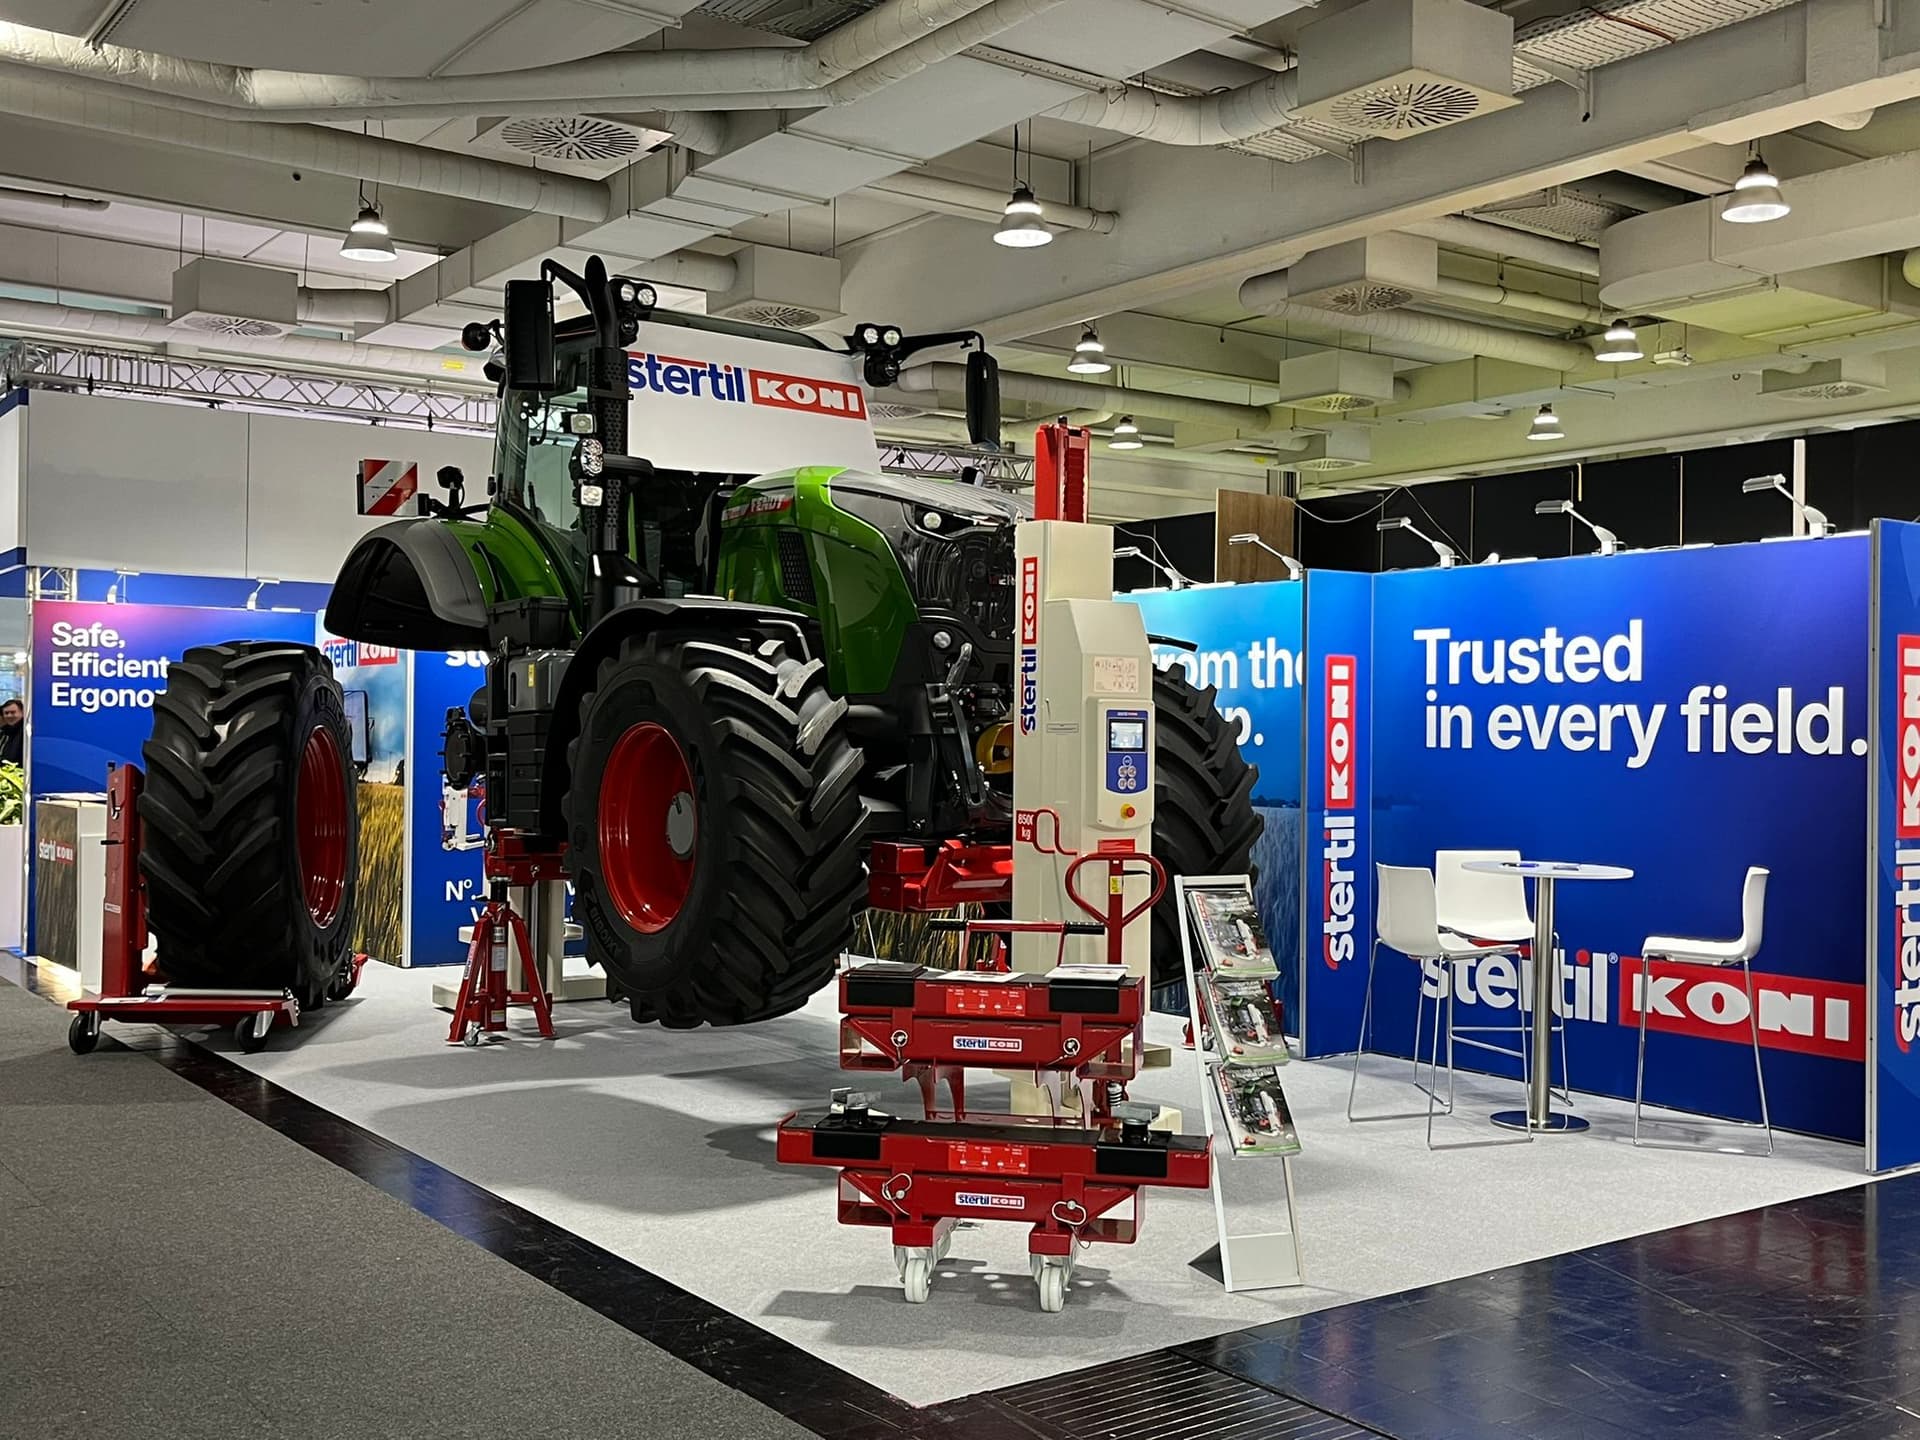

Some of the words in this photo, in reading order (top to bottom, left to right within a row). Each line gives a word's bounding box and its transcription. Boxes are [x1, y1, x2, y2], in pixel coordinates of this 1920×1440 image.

[628, 352, 746, 403] stertil
[755, 377, 860, 412] KONI
[1024, 561, 1036, 641] KONI
[51, 621, 126, 649] Safe,
[51, 651, 171, 679] Efficient
[1413, 619, 1643, 686] Trusted
[51, 682, 167, 713] Ergono
[1021, 647, 1037, 735] stertil
[1330, 664, 1350, 800] KONI
[1424, 690, 1473, 750] in
[1487, 700, 1667, 769] every
[1680, 685, 1869, 756] field.
[1021, 826, 1032, 841] kg
[1323, 815, 1356, 969] stertil
[1632, 974, 1850, 1042] KONI
[954, 1037, 988, 1049] stertil
[988, 1040, 1020, 1050] KONI
[957, 1194, 990, 1206] stertil
